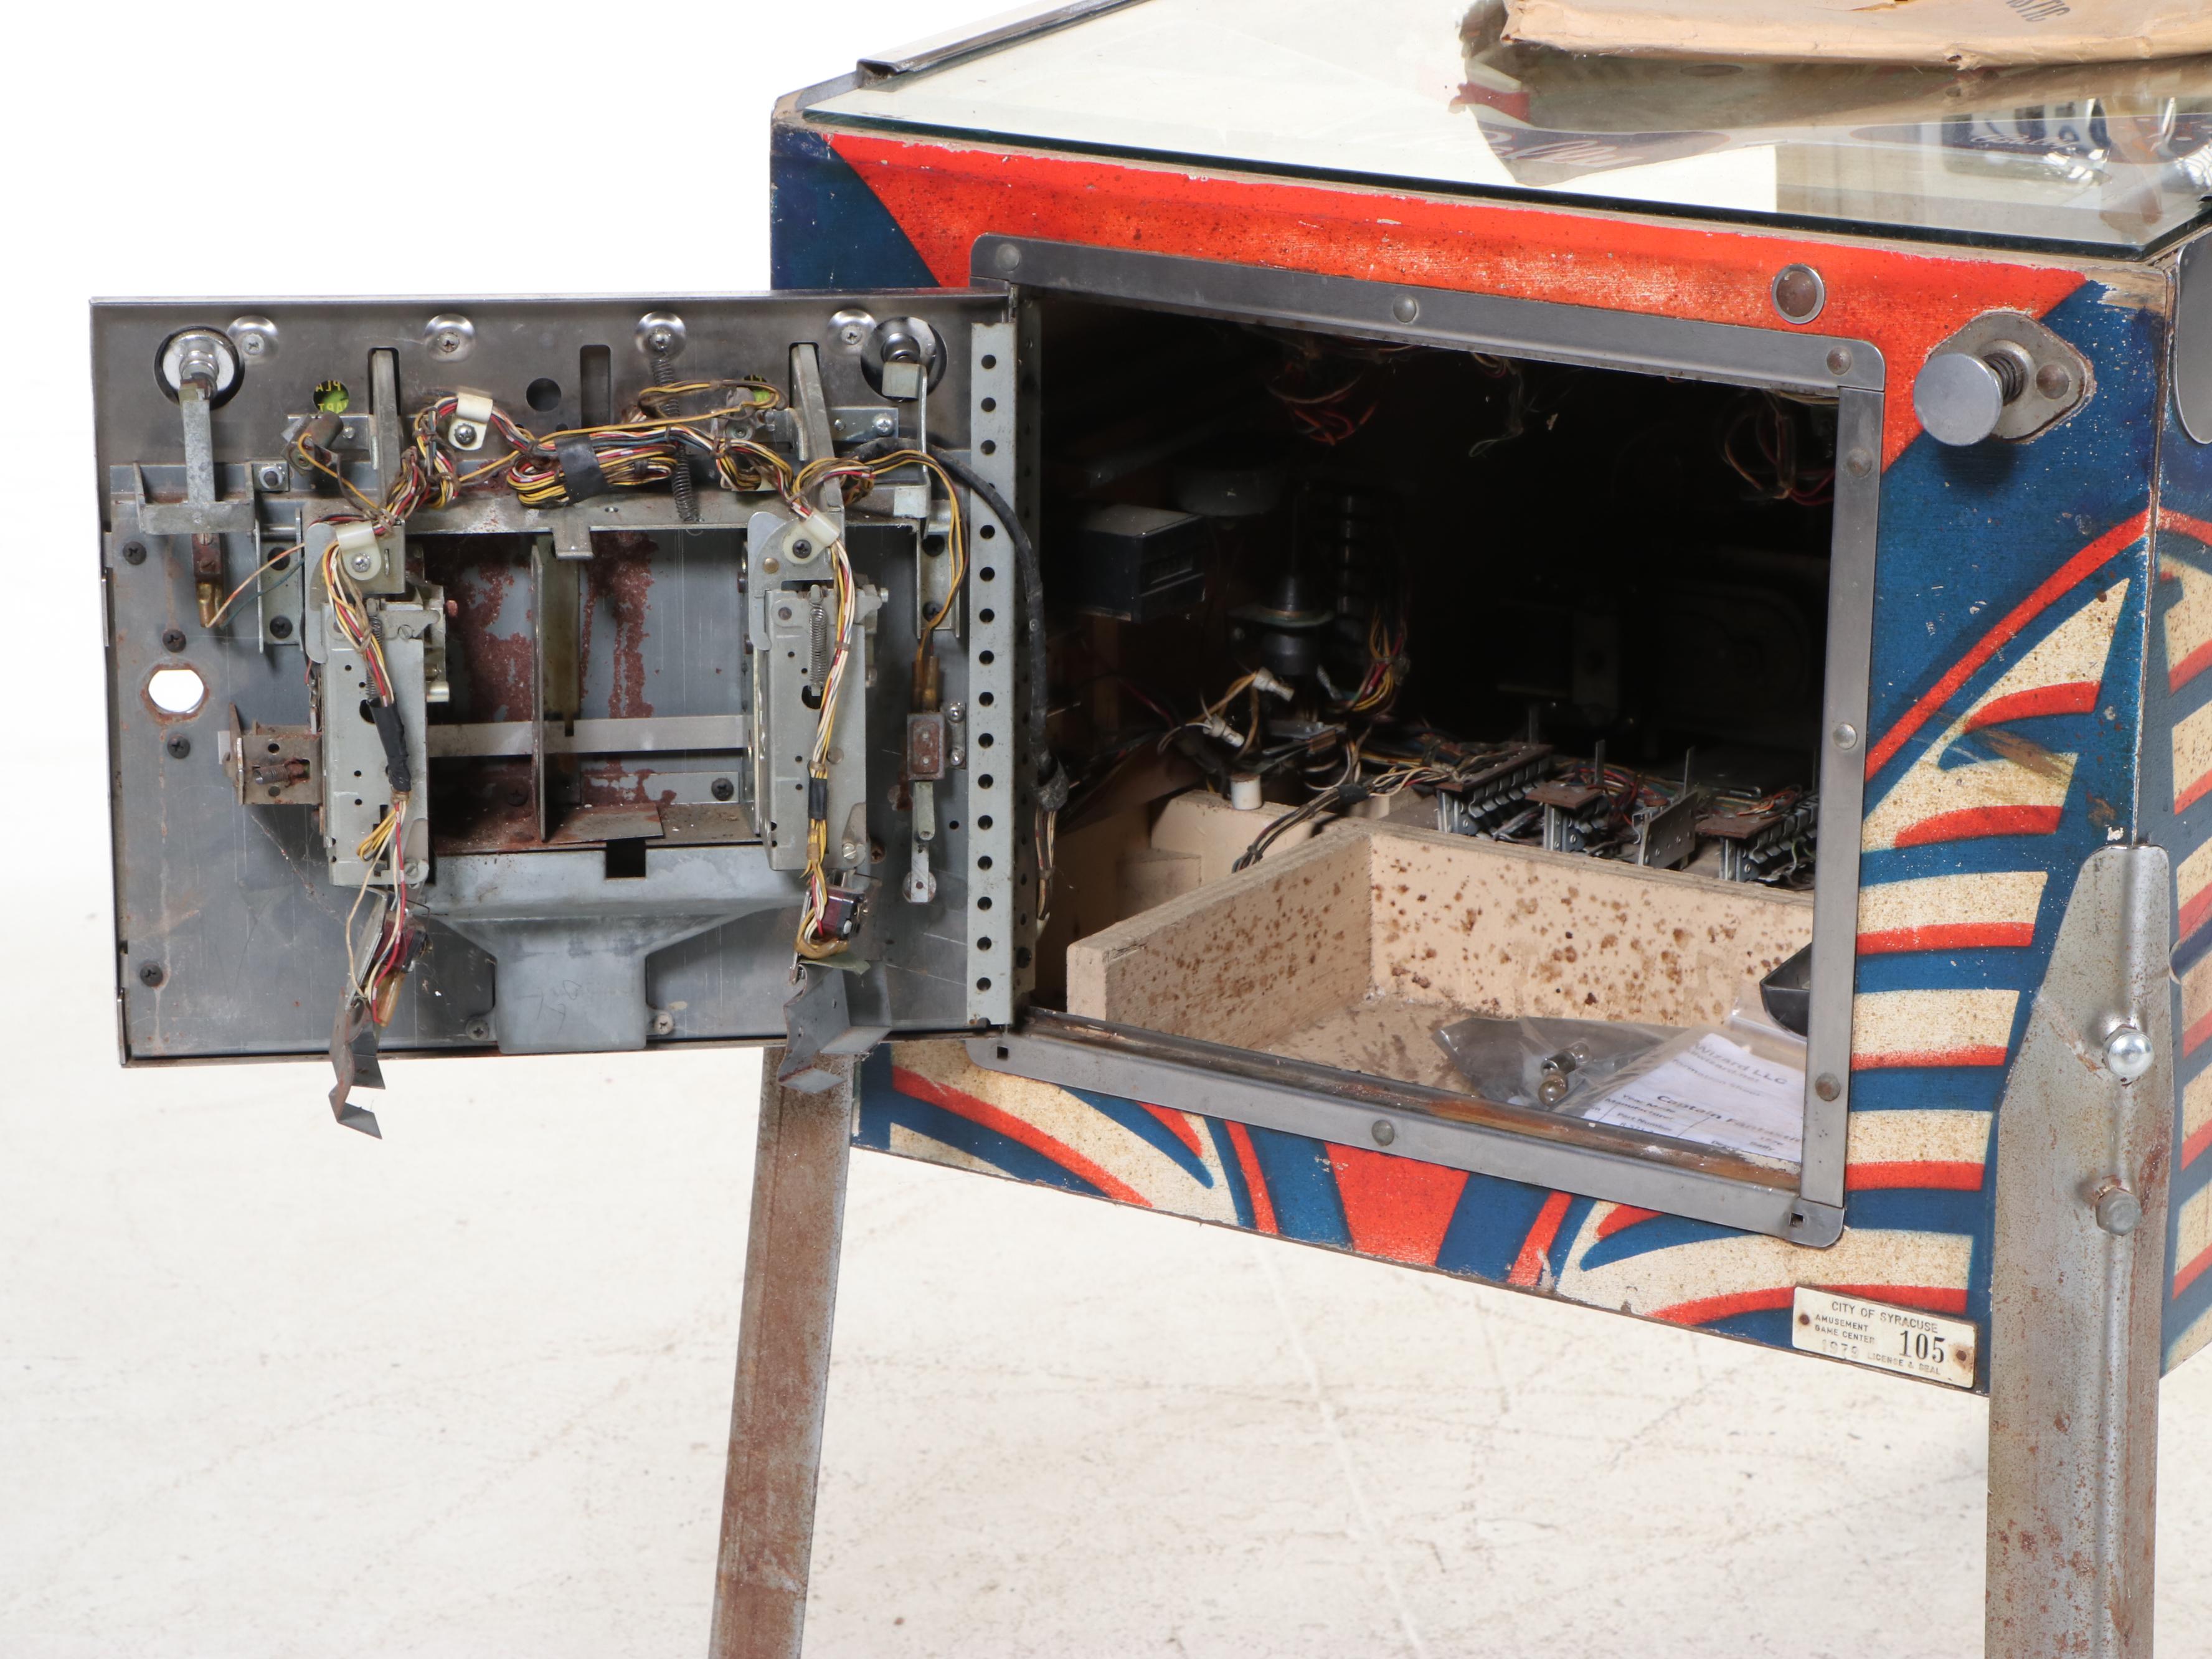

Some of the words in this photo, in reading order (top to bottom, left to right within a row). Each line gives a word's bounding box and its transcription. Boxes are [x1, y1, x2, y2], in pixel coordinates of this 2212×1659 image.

[1753, 1069, 1788, 1085] LLC
[1657, 1095, 1722, 1120] Captain
[1815, 1313, 1869, 1332] AMUSEMENT
[1832, 1301, 1855, 1314] CITY
[1860, 1308, 1874, 1319] OF
[1879, 1312, 1938, 1334] SYRACUSE
[1815, 1324, 1839, 1336] GAME
[1842, 1331, 1874, 1345] CENTER
[1899, 1330, 1945, 1364] 105
[1868, 1351, 1904, 1367] LICENSE
[1918, 1362, 1940, 1375] SEAL
